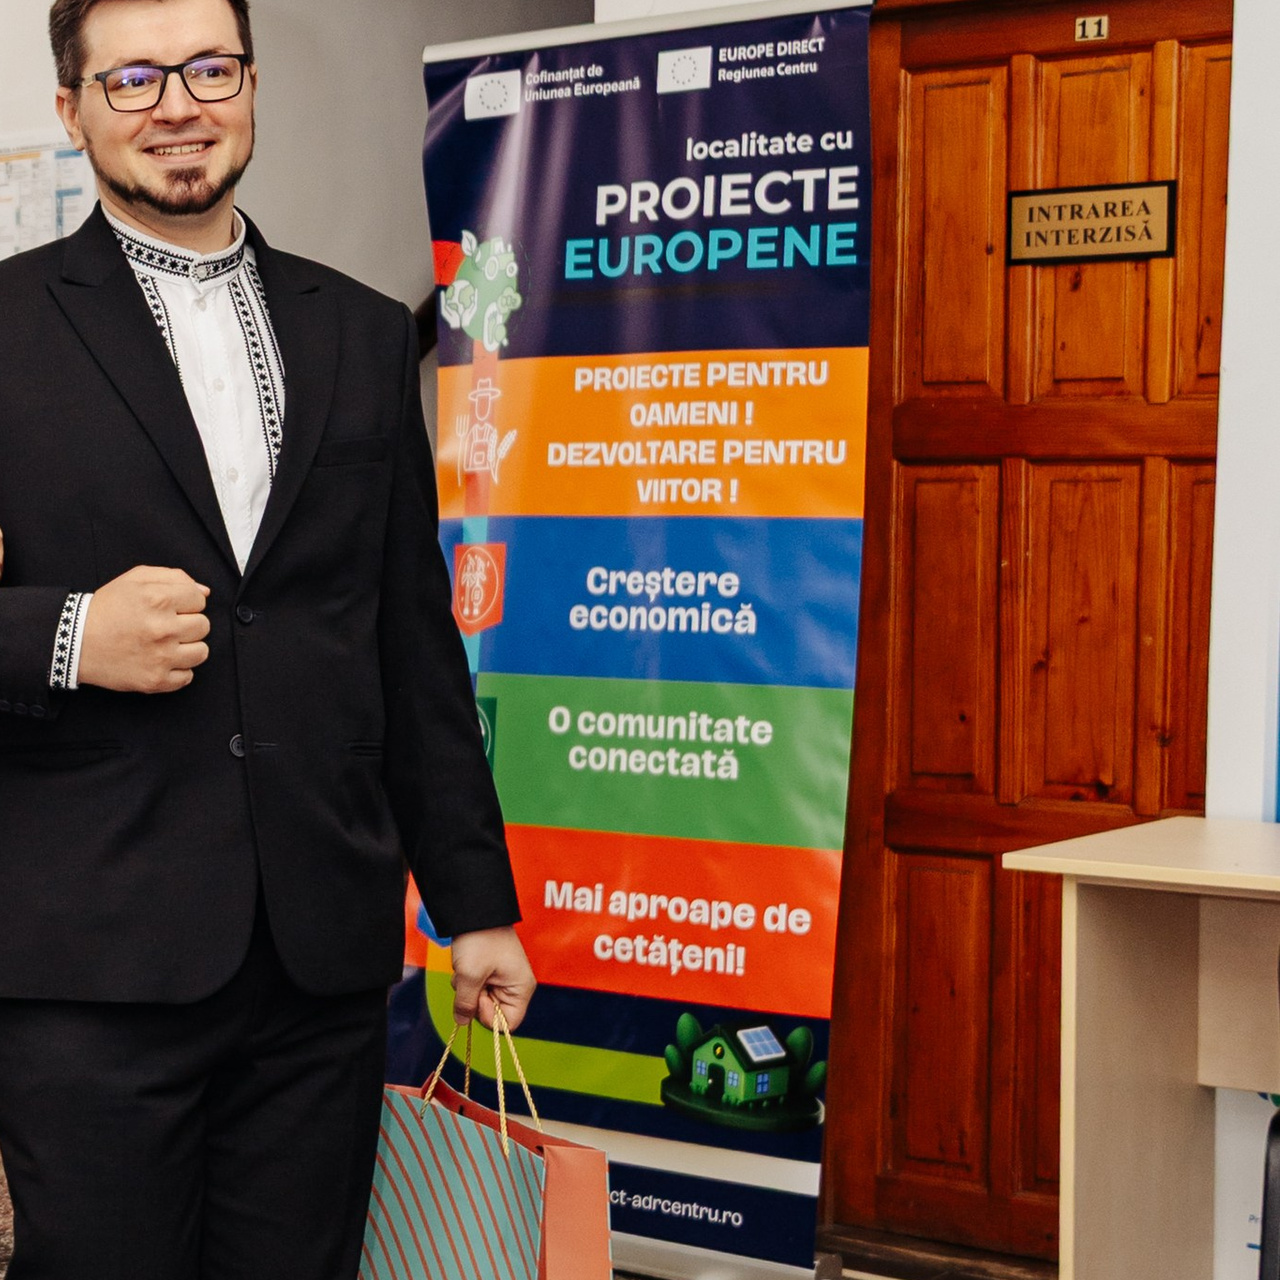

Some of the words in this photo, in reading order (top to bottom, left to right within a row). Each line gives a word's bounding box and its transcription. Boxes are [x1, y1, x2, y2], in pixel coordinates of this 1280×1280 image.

[1077, 18, 1105, 39] 11
[719, 44, 774, 62] EUROPE
[777, 37, 825, 56] DIRECT
[525, 66, 585, 86] Cofinanțat
[587, 65, 603, 78] de
[718, 65, 775, 82] Regiunea
[777, 61, 818, 76] Centru
[525, 86, 571, 102] Uniunea
[574, 77, 640, 97] Europeană
[686, 131, 813, 161] localitate
[819, 131, 852, 152] cu
[596, 166, 859, 226] PROIECTE
[1028, 200, 1151, 223] INTRAREA
[1025, 220, 1152, 248] INTERZISĂ
[564, 222, 858, 280] EUROPENE
[574, 362, 700, 392] PROIECTE
[706, 360, 828, 386] PENTRU
[630, 401, 738, 428] OAMENI
[547, 440, 716, 467] DEZVOLTARE
[722, 439, 847, 465] PENTRU
[637, 478, 722, 503] VIITOR
[587, 565, 740, 602] Creștere
[569, 603, 756, 635] economică
[548, 705, 571, 734] O
[577, 710, 773, 746] comunitate
[568, 744, 739, 780] conectată
[544, 880, 603, 913] Mai
[608, 888, 756, 932] aproape
[763, 902, 812, 935] de
[593, 934, 746, 976] cetățeni!
[610, 1189, 743, 1227] ct-adrcentru.ro
